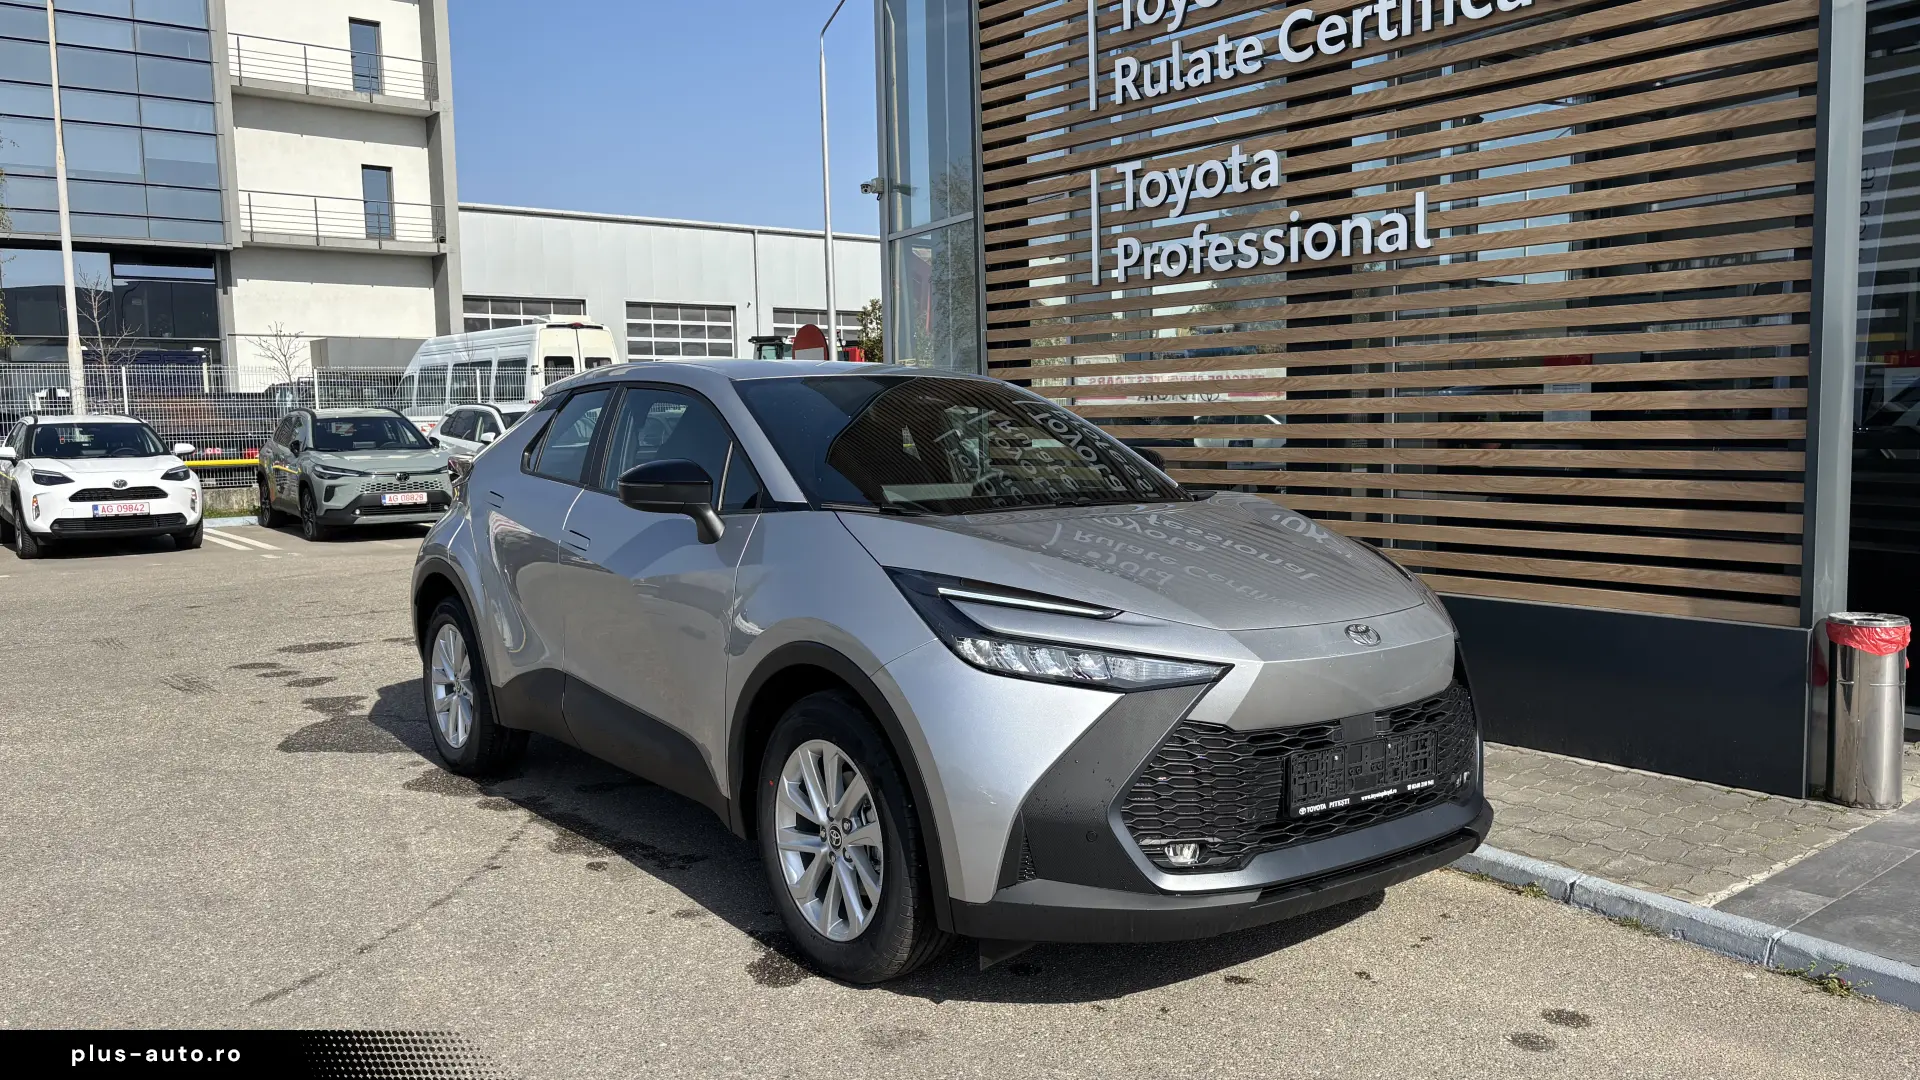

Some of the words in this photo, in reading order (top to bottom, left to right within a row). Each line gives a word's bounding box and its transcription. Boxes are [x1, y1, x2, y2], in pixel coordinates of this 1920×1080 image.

[1114, 34, 1265, 104] Rulate
[1116, 144, 1282, 218] Toyota
[1117, 191, 1432, 282] Professional
[101, 505, 114, 513] AG
[116, 503, 145, 513] 09842
[388, 494, 399, 502] AG
[1306, 803, 1326, 813] TOYOTA
